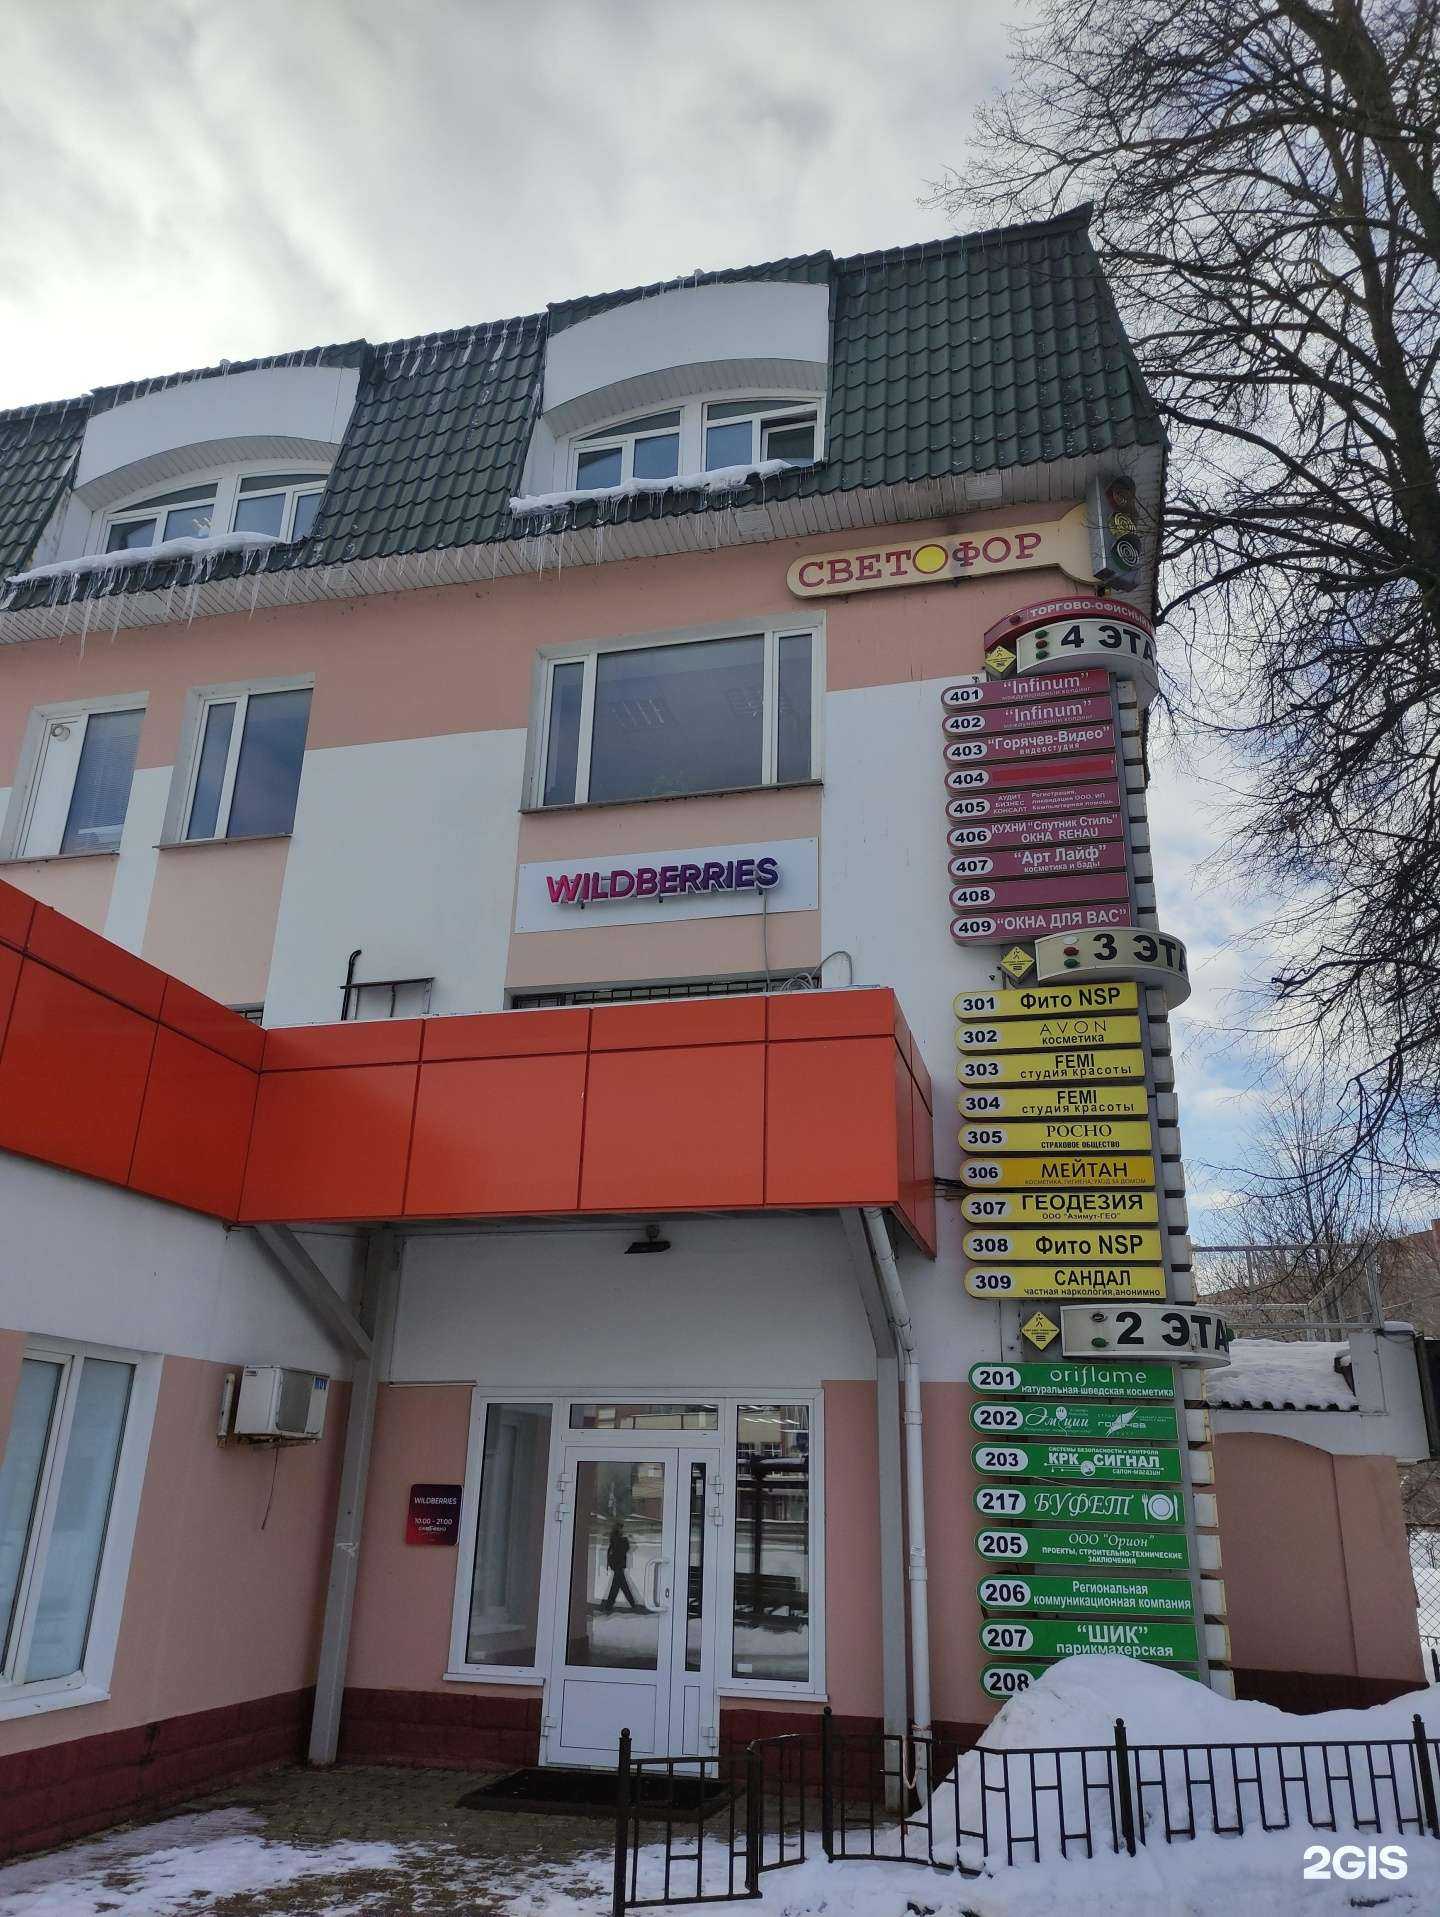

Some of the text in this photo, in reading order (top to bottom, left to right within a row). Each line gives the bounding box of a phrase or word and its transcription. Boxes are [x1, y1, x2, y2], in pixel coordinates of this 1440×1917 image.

[799, 532, 1042, 588] СВЕТОФОР
[1060, 625, 1084, 648] 4
[1003, 672, 1089, 694] "Infinum"
[950, 688, 979, 702] 401
[1005, 700, 1092, 722] "Infinum"
[950, 717, 982, 730] 402
[988, 725, 1110, 750] "Горячев-Видео"
[951, 744, 983, 757] 403
[1019, 743, 1080, 756] видеостудия
[952, 772, 985, 786] 404
[953, 801, 986, 814] 405
[993, 806, 1027, 815] КОНСАЛТ
[995, 800, 1025, 808] БИЗНЕС
[991, 822, 1026, 834] КУХНИ
[1079, 814, 1118, 826] Стиль"
[954, 831, 987, 843] 406
[1021, 828, 1098, 843] ОКНА REHAU
[1014, 845, 1106, 866] "Арт Лайф"
[956, 860, 989, 873] 407
[1024, 862, 1067, 873] косметика
[1076, 860, 1100, 870] бады
[546, 857, 779, 904] WILDBERRIES
[957, 889, 990, 903] 408
[997, 909, 1127, 930] "ОКНА ДЛЯ ВАС"
[958, 920, 992, 934] 409
[1093, 933, 1118, 961] 3
[963, 997, 996, 1011] 301
[1020, 987, 1121, 1010] Фито NSP
[1039, 1019, 1107, 1035] AVON
[963, 1030, 997, 1043] 302
[1042, 1034, 1104, 1045] косметика
[1054, 1053, 1095, 1069] FEMI
[964, 1063, 999, 1077] 303
[1020, 1066, 1132, 1080] студия красоты
[965, 1097, 1001, 1111] 304
[1057, 1090, 1097, 1105] FEMI
[1022, 1103, 1134, 1116] студия красоты
[967, 1130, 1003, 1144] 305
[1046, 1124, 1112, 1138] РОСНО
[1041, 1141, 1120, 1149] СТРАХОВОЕ ОБЩЕСТВО
[967, 1166, 999, 1180] 306
[1041, 1159, 1127, 1178] МЕЙТАН
[970, 1201, 1007, 1215] 307
[1021, 1194, 1143, 1212] ГЕОДЕЗИЯ
[972, 1238, 1009, 1253] 308
[1035, 1234, 1143, 1255] Фито NSP
[975, 1275, 1012, 1289] 309
[1054, 1270, 1131, 1288] САНДАЛ
[1024, 1287, 1059, 1296] частная
[1116, 1311, 1229, 1353] 2 ЭТА
[979, 1370, 1015, 1386] 201
[1050, 1366, 1147, 1387] oriflame
[1021, 1386, 1174, 1397] натуральная шведская косметика
[979, 1410, 1018, 1426] 202
[985, 1452, 1019, 1467] 203
[1048, 1452, 1160, 1467] КРК СИГНАЛ
[1112, 1468, 1161, 1476] салон-магазин
[414, 1497, 457, 1505] WILDBERRIES
[982, 1493, 1020, 1511] 217
[1034, 1492, 1135, 1517] БУФЕТ
[982, 1535, 1022, 1553] 205
[1069, 1533, 1099, 1545] ООО
[1042, 1546, 1183, 1560] ПРОЕКТЫ, СТРОИТЕЛЬНО-ТЕХНИЧЕСКИЕ
[1088, 1556, 1136, 1564] ЗАКЛЮЧЕНИЯ
[984, 1583, 1026, 1602] 206
[1072, 1581, 1148, 1595] Региональная
[1033, 1595, 1191, 1609] коммуникационная компания
[987, 1628, 1027, 1647] 207
[1077, 1624, 1148, 1644] "ШИК"
[1056, 1643, 1174, 1657] парикмахерская
[989, 1672, 1030, 1692] 208
